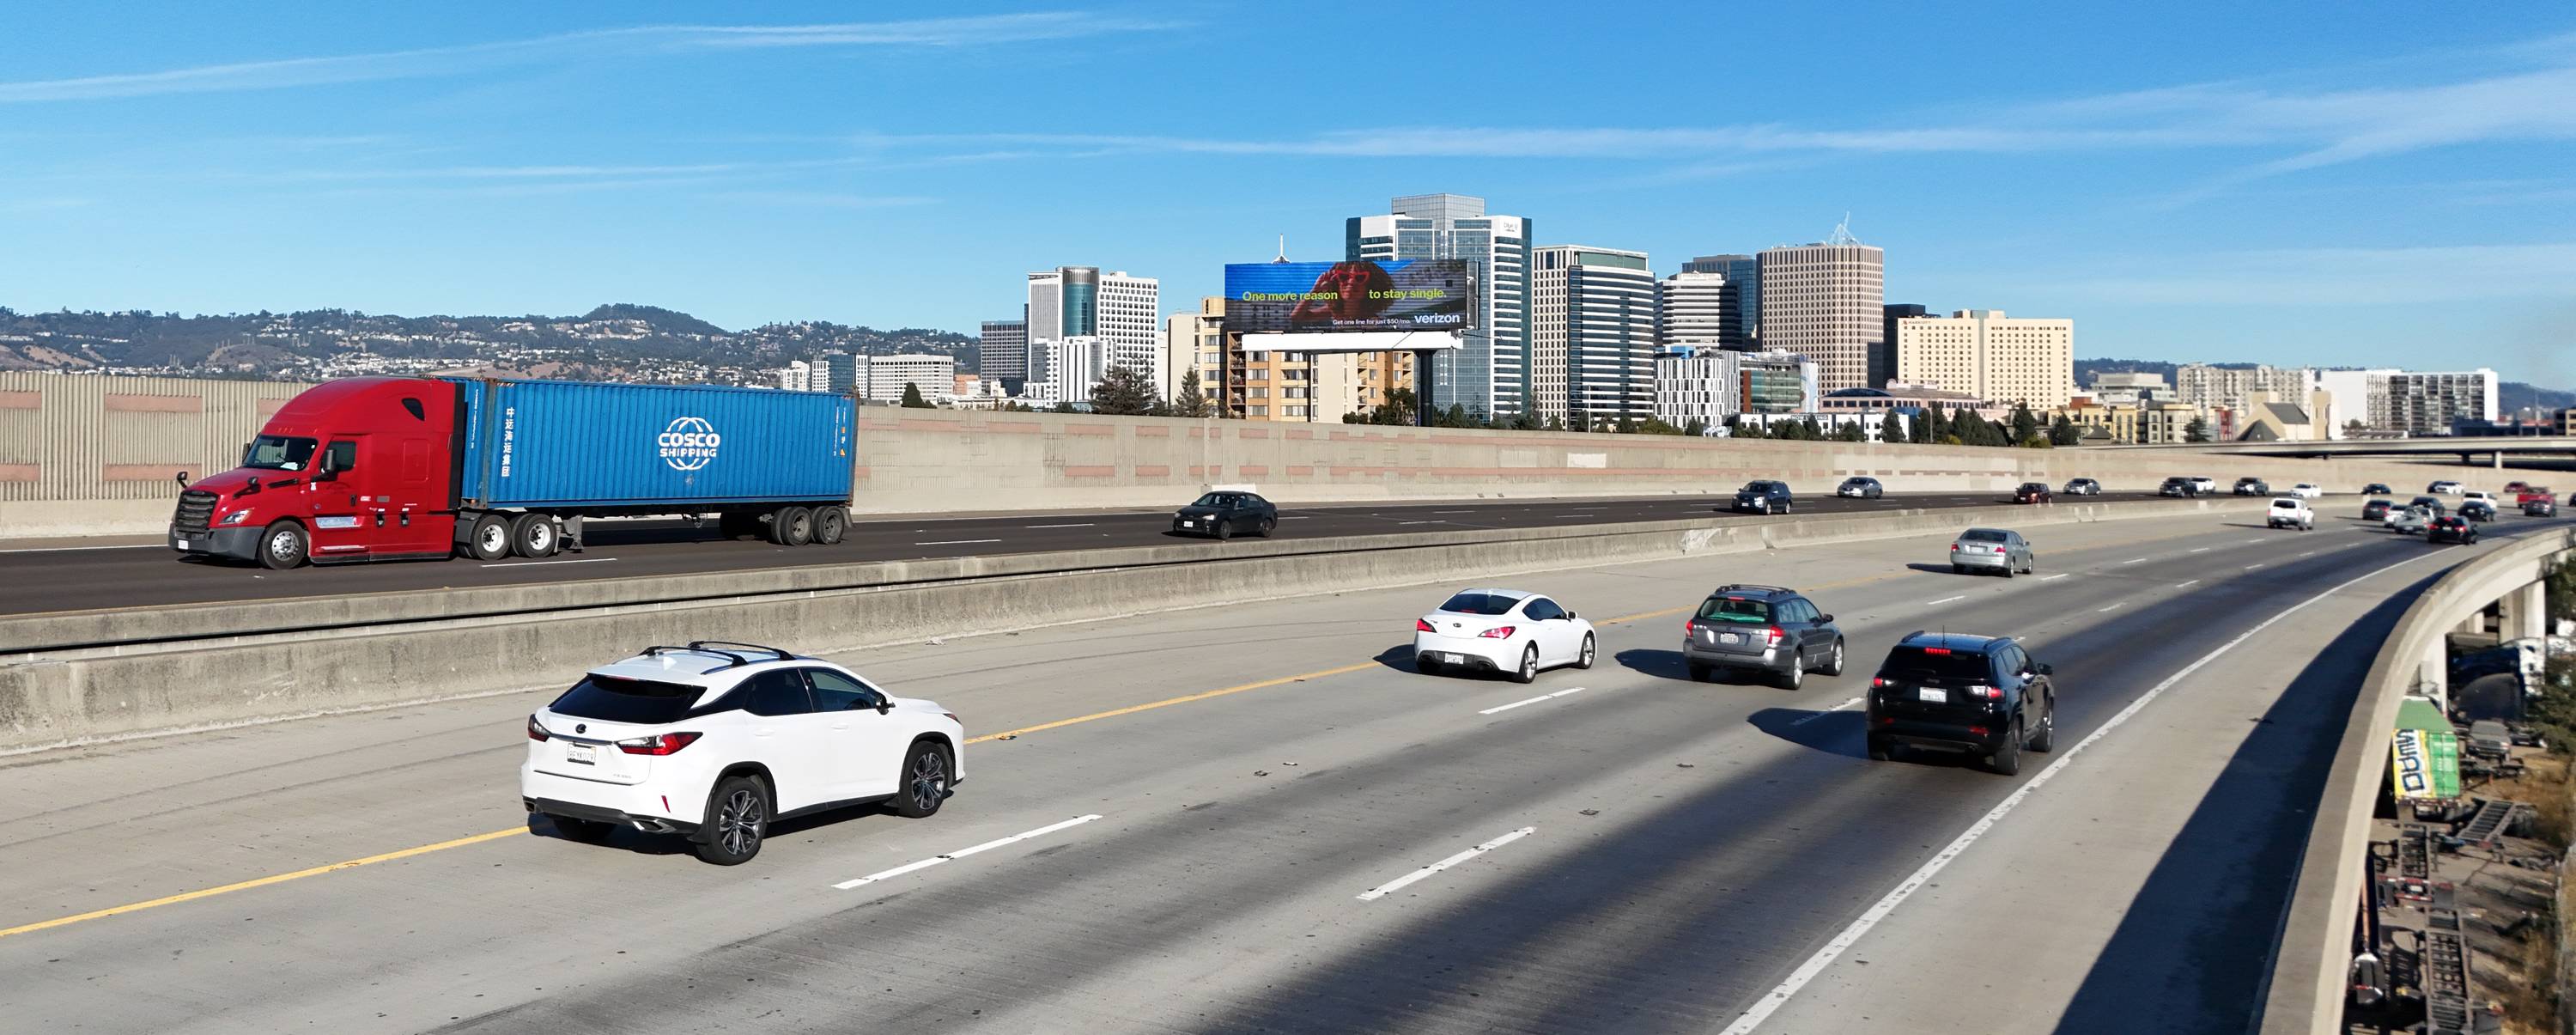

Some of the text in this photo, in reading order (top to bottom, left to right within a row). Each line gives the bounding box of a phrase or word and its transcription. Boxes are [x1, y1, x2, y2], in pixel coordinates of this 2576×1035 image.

[1242, 291, 1266, 301] One
[1300, 292, 1338, 301] reason
[1369, 289, 1381, 299] to
[1383, 289, 1407, 301] stay
[1410, 289, 1447, 300] single.
[1414, 313, 1460, 324] verizon
[658, 432, 721, 447] COSCO
[659, 447, 717, 458] SHIPPING
